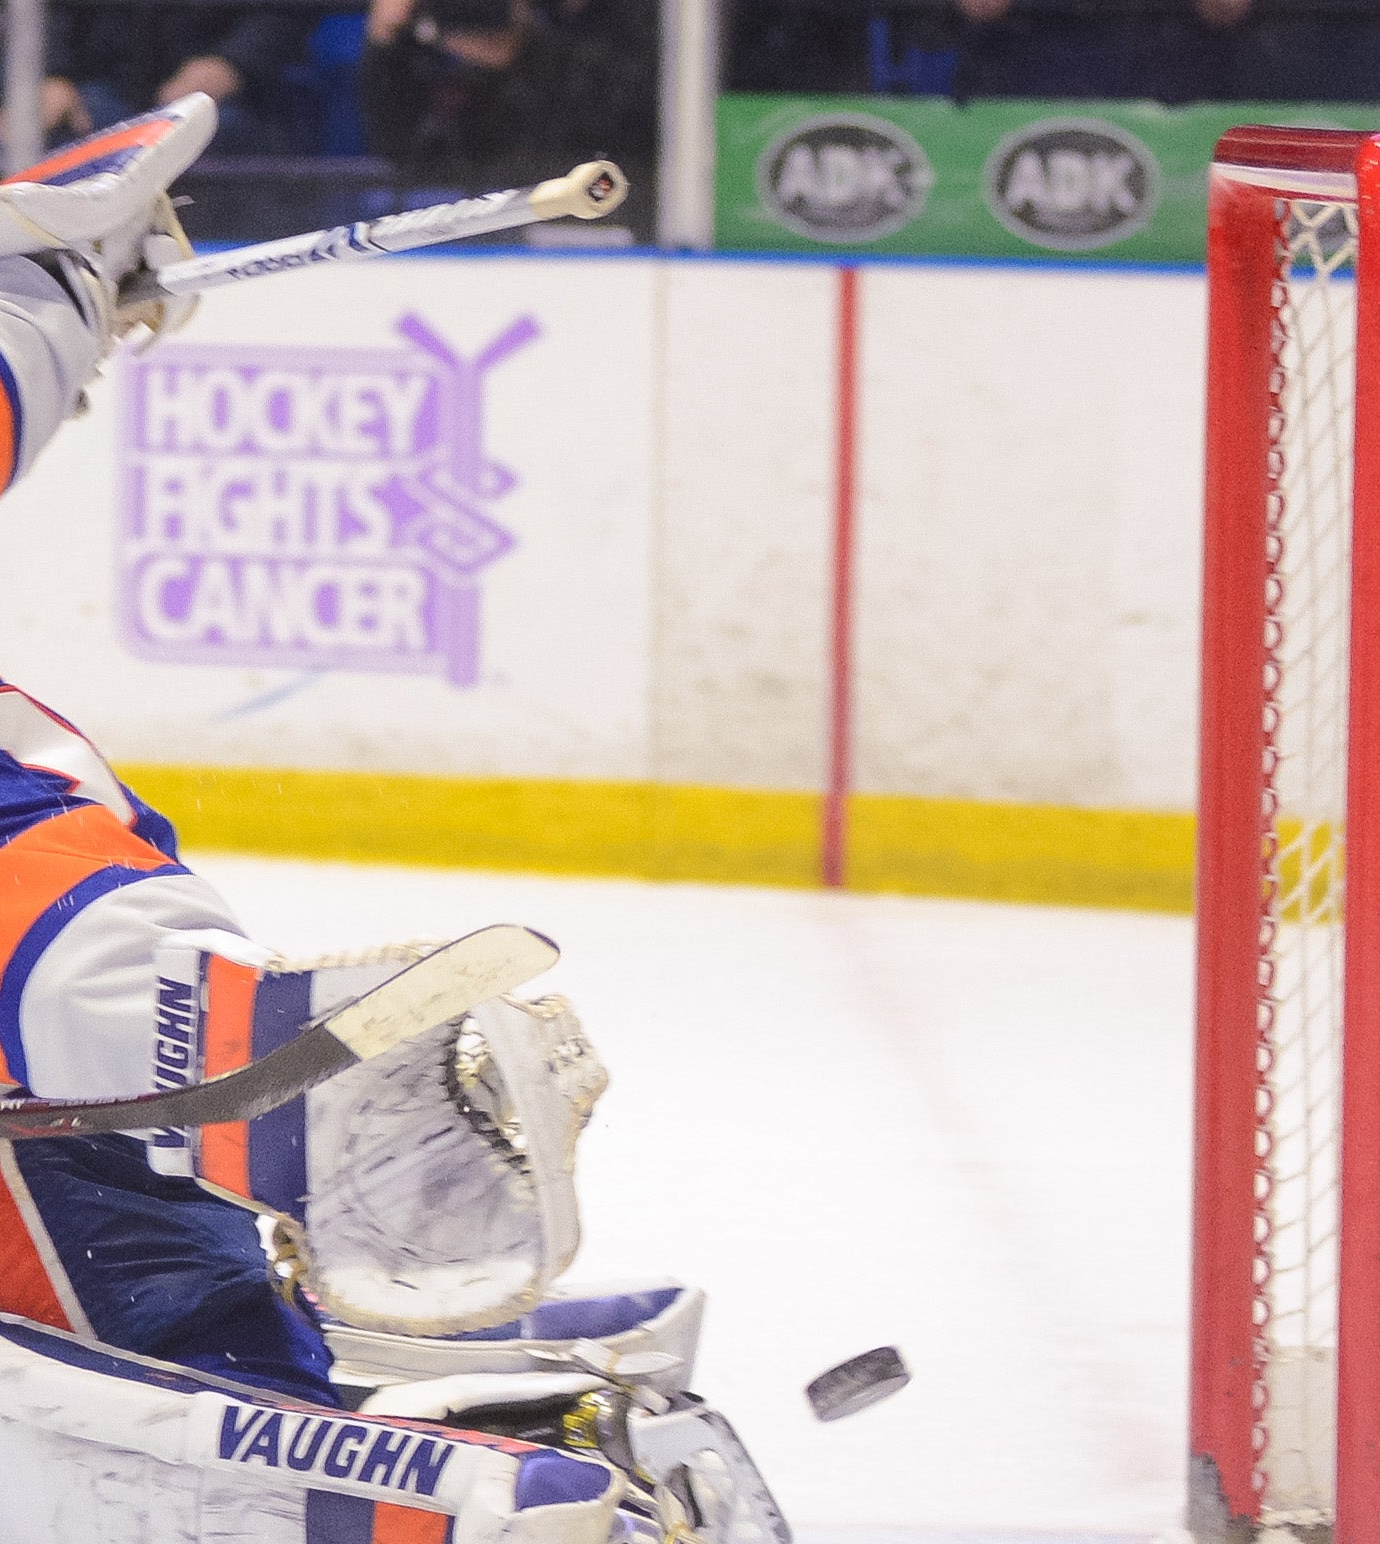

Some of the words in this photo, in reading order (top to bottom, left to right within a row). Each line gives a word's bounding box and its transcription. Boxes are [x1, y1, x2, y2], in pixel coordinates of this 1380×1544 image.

[778, 146, 907, 204] ADK
[1008, 152, 1135, 213] ADK
[145, 363, 429, 457] HOCKEY
[145, 460, 395, 555] FIGHTS
[141, 556, 426, 652] CANCER
[153, 976, 192, 1148] VUGHN
[218, 1404, 456, 1497] VAUGHN
